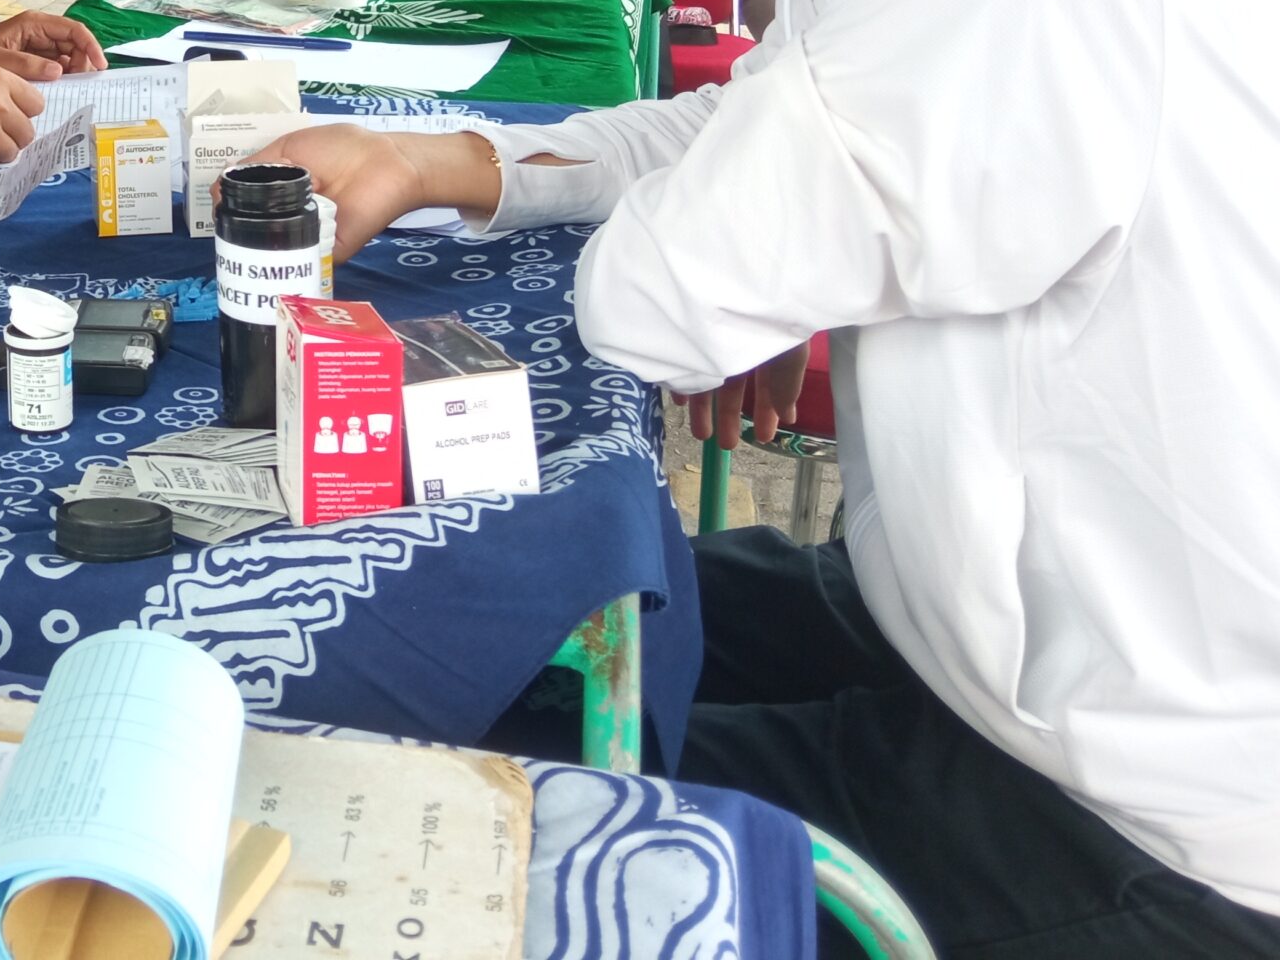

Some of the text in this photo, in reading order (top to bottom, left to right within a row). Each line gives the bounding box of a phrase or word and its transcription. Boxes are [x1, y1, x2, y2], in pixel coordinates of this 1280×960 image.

[248, 262, 313, 280] SAMPAH
[26, 403, 42, 414] 71
[435, 431, 511, 448] ALCOHOL PREP PADS
[426, 481, 441, 491] 100
[427, 491, 443, 499] PCS
[425, 801, 442, 812] %
[422, 814, 440, 835] 100
[306, 921, 345, 949] Z
[329, 880, 347, 897] 5/6
[348, 794, 365, 806] %
[410, 888, 428, 906] 5/5
[485, 894, 503, 912] 5/3
